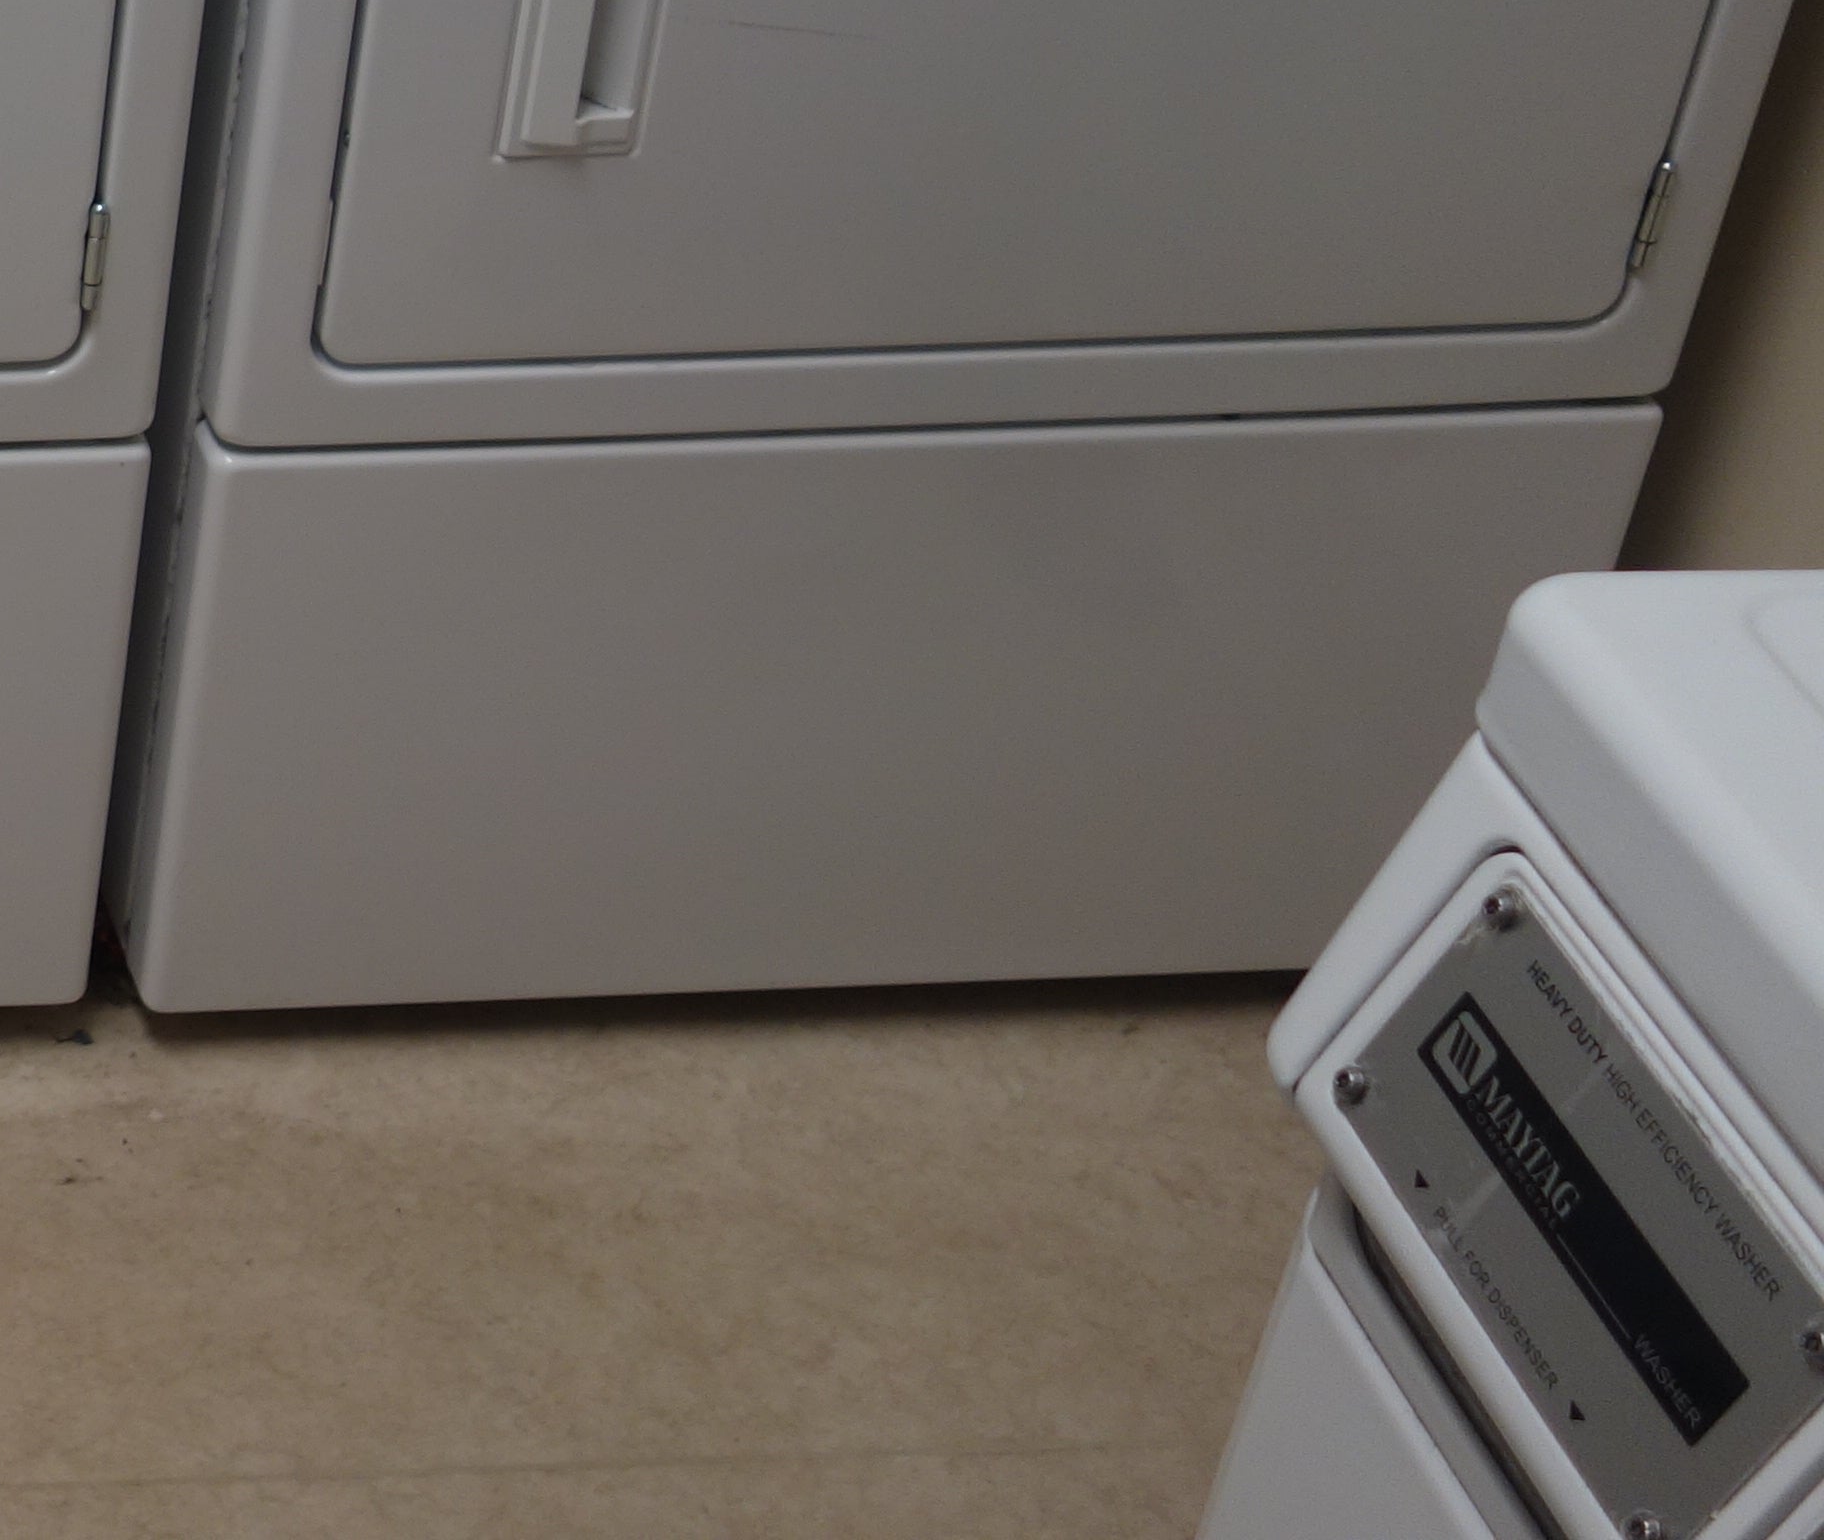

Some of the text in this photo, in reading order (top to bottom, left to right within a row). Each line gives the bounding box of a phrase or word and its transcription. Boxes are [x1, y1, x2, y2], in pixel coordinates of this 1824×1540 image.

[1474, 1075, 1580, 1218] MAYTAG
[1526, 959, 1783, 1302] HEAVY DUTY HIGH EFFICIENCY WASHER
[1433, 1205, 1559, 1390] PULL FOR DISPENSER
[1633, 1333, 1703, 1428] WASHER
